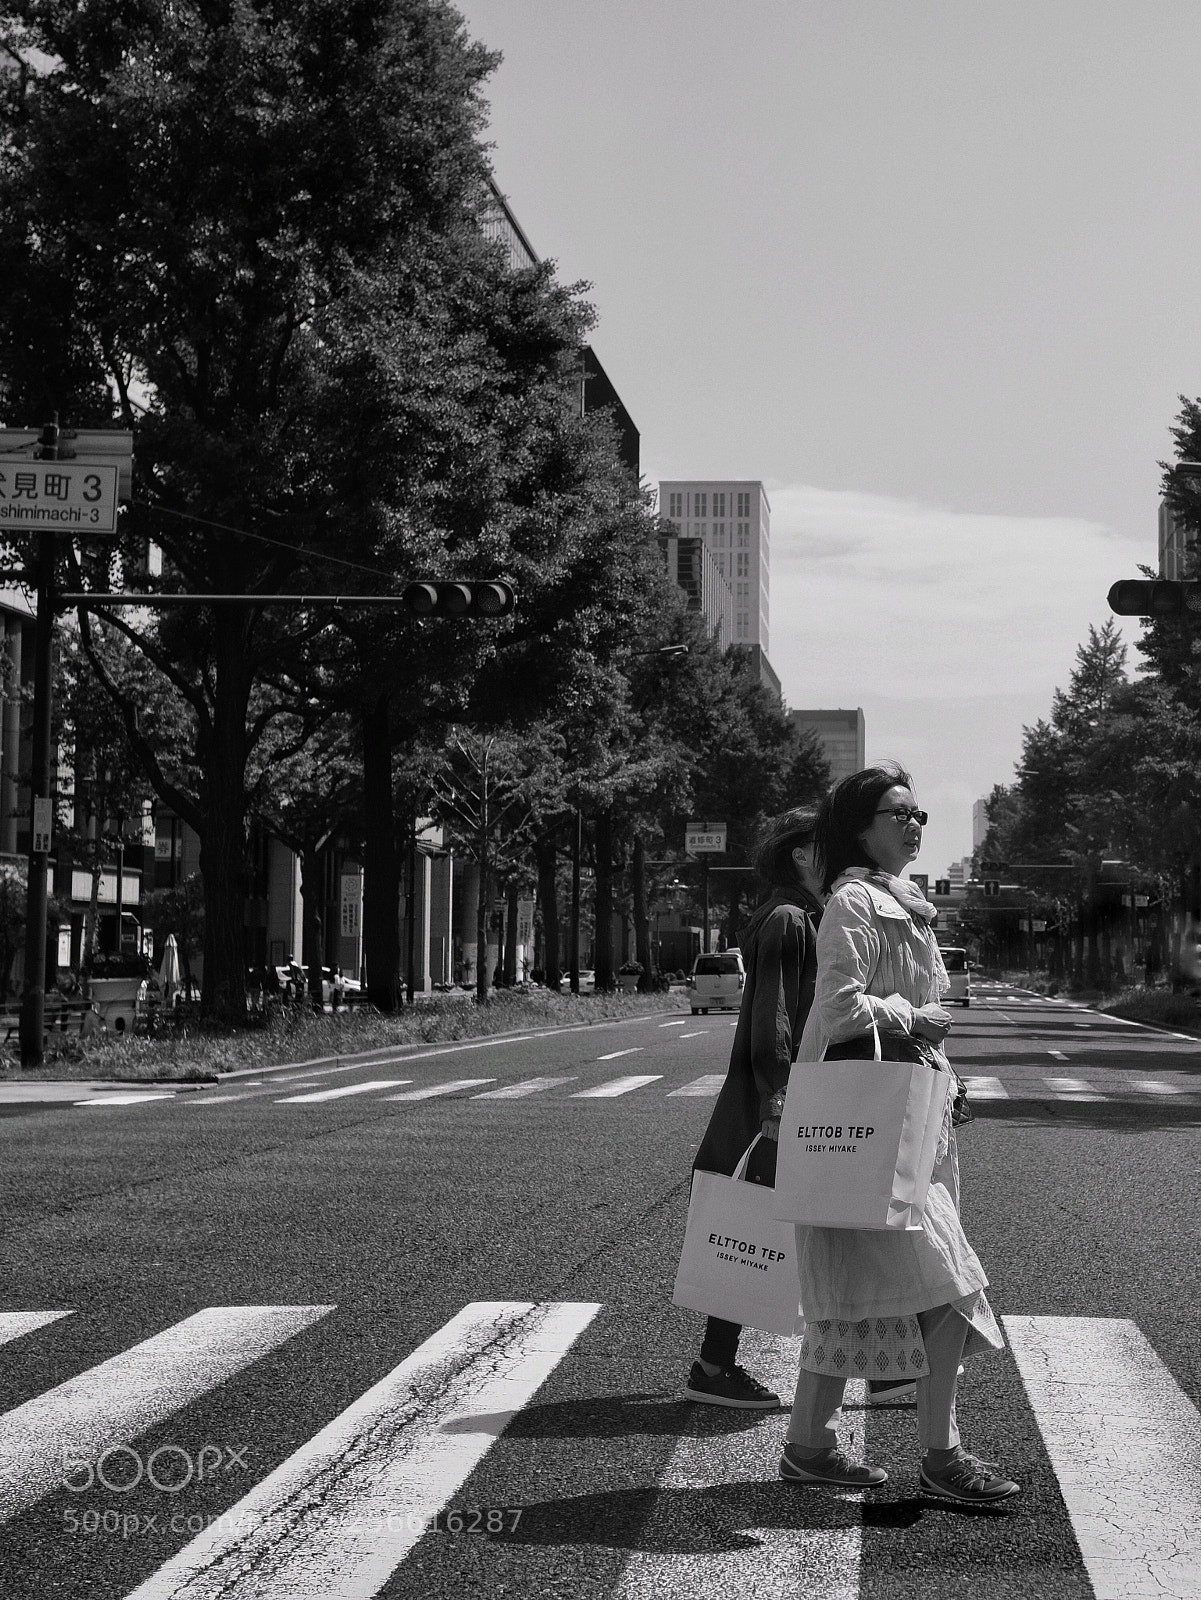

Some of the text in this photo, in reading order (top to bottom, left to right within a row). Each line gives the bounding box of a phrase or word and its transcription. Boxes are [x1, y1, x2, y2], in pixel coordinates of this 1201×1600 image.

[0, 472, 102, 502] 見町 3
[0, 503, 100, 523] shimimachi-3
[715, 835, 722, 844] 3
[797, 1126, 875, 1139] ELTTOB TEP
[805, 1145, 857, 1153] ISSEY MIYAKE
[708, 1233, 786, 1262] ELTTOB TEP
[716, 1251, 769, 1272] ISSEY MIYAKE
